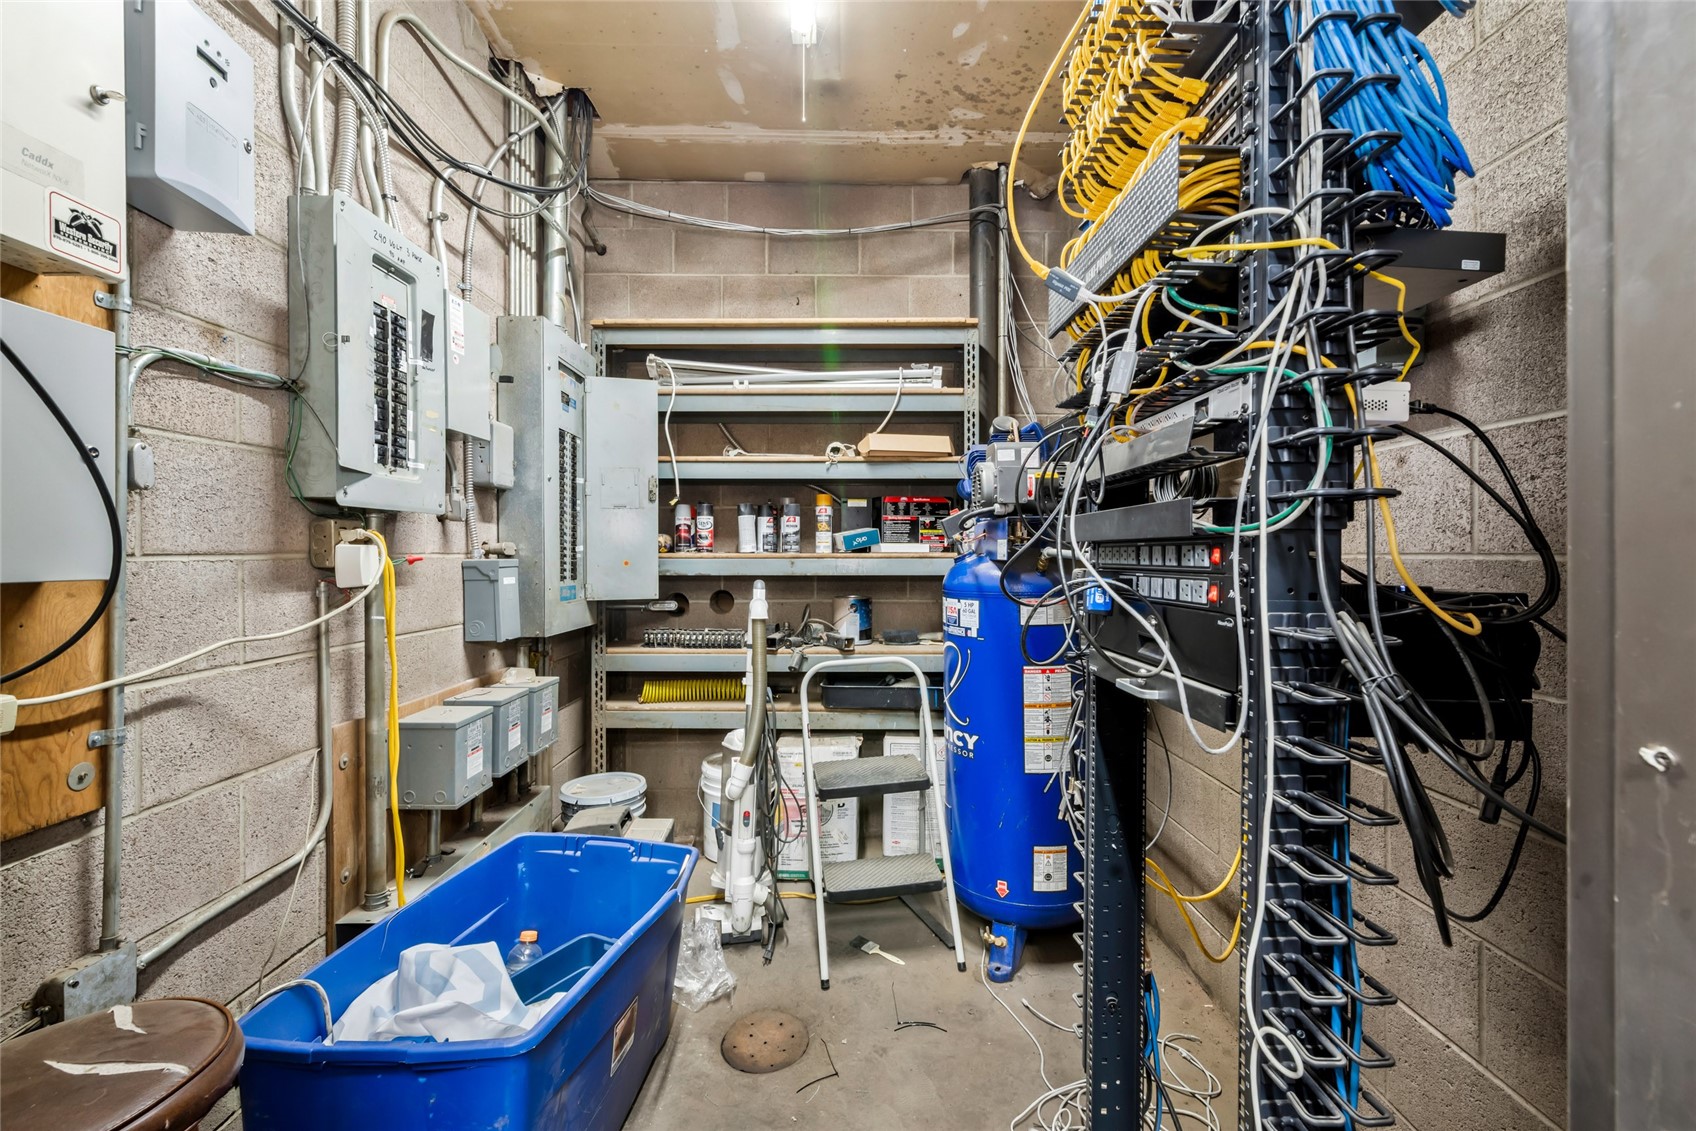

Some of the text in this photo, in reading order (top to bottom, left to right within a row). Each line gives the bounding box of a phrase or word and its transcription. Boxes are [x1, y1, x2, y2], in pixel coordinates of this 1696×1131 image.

[21, 147, 55, 170] Caddx
[58, 220, 114, 253] Western Security
[373, 229, 387, 244] 240
